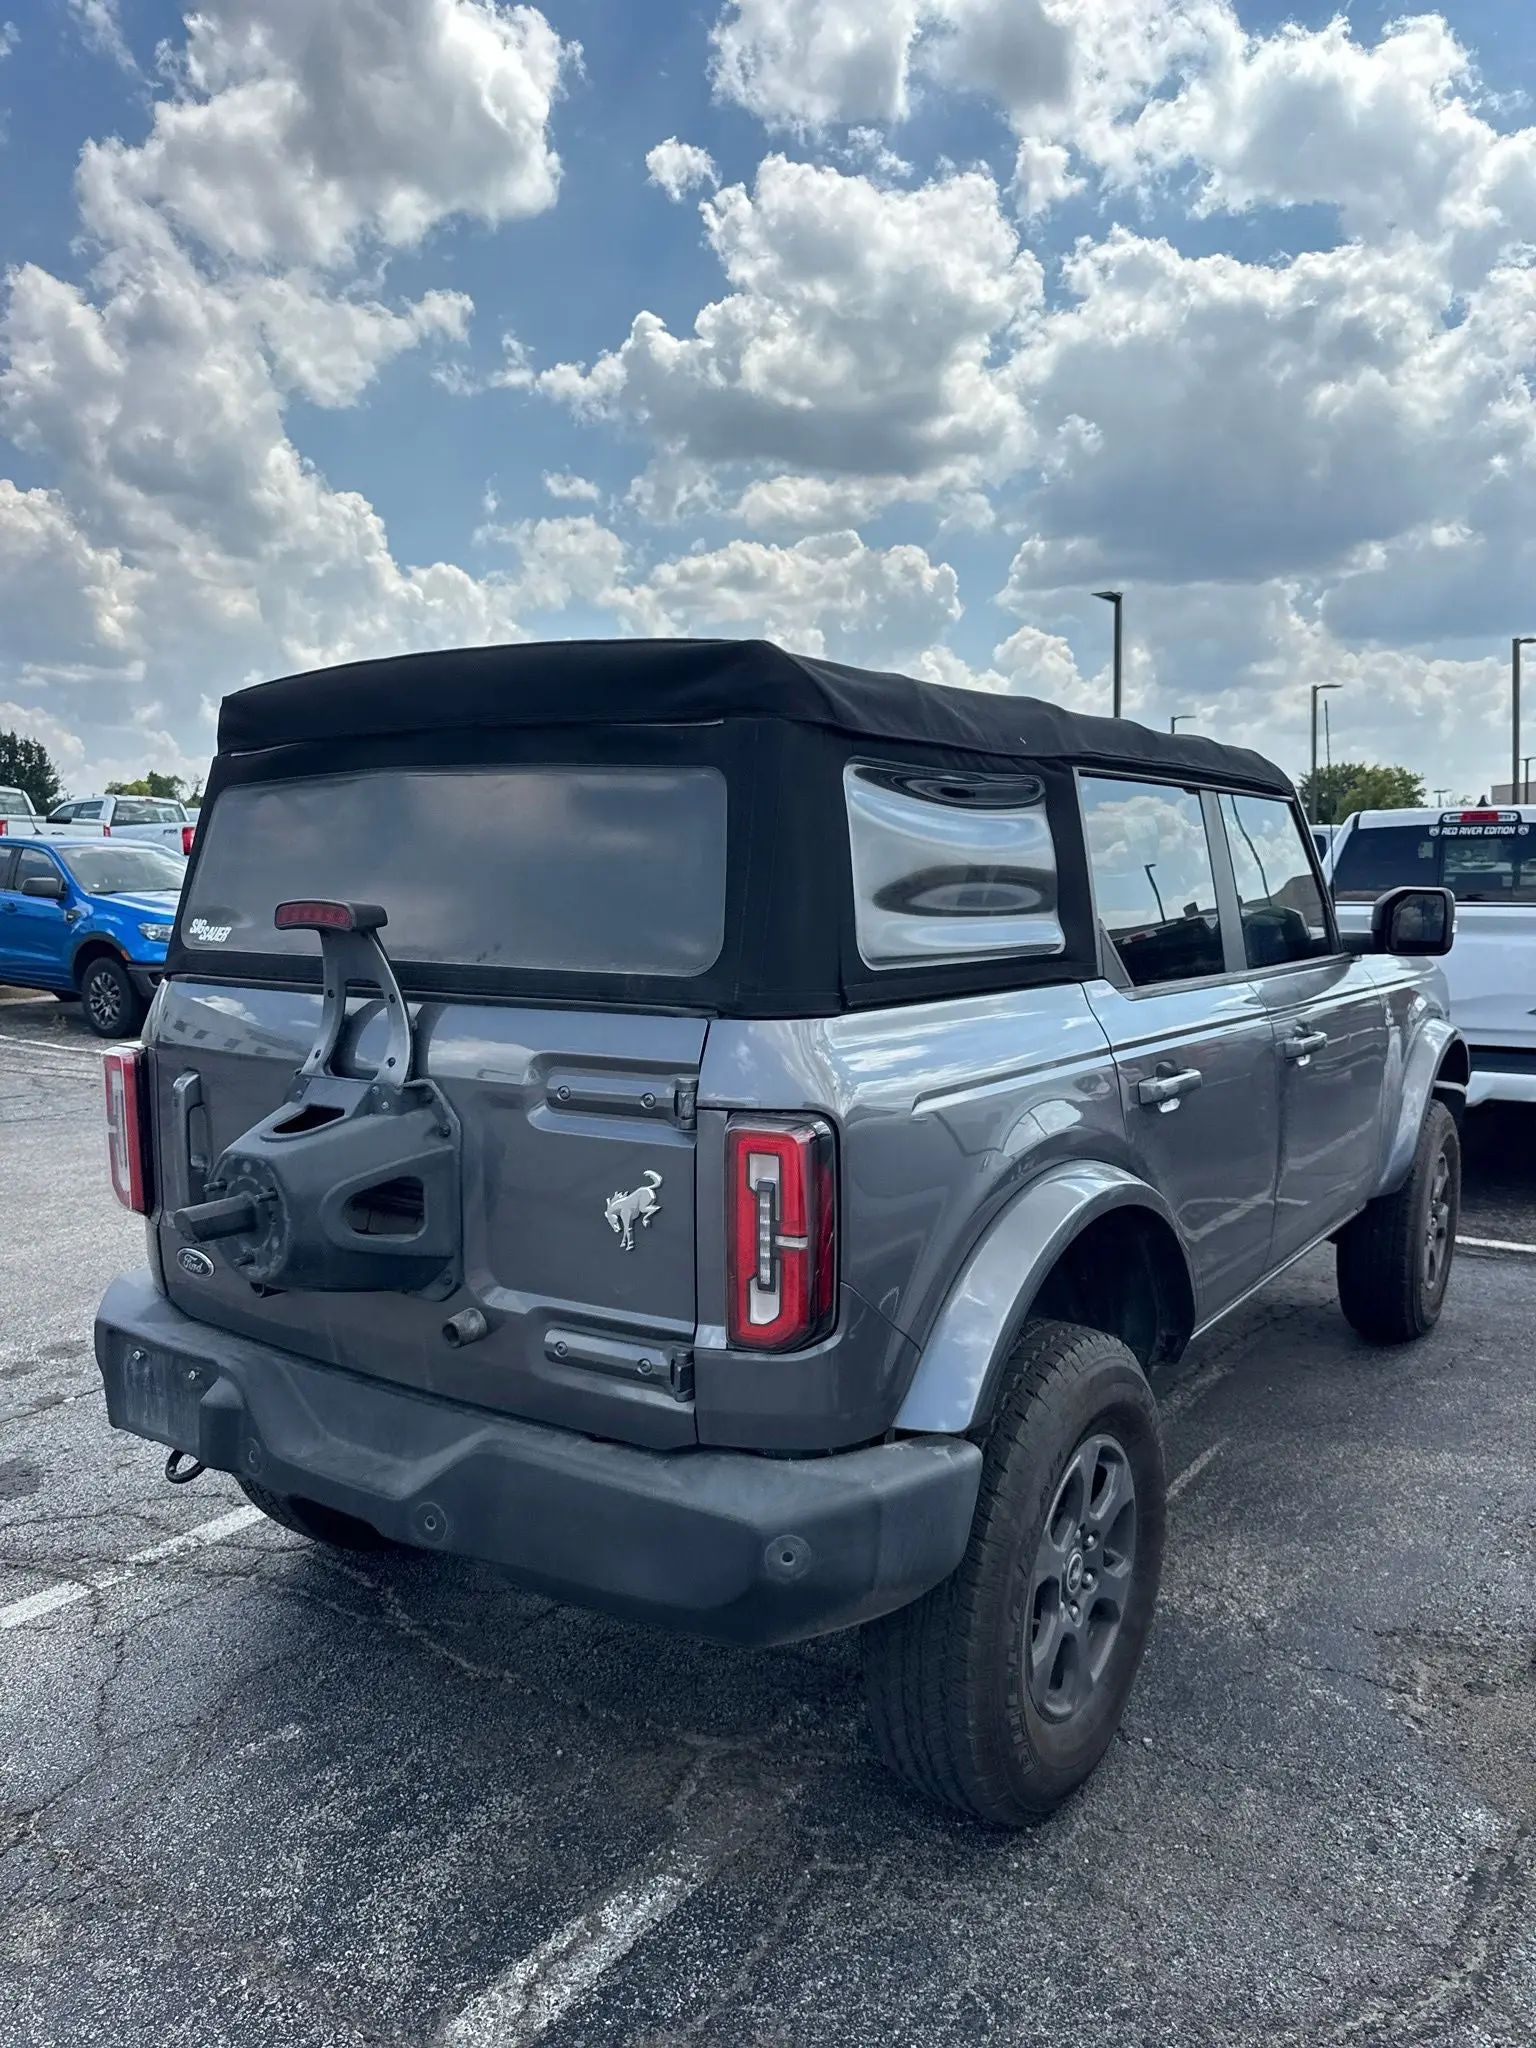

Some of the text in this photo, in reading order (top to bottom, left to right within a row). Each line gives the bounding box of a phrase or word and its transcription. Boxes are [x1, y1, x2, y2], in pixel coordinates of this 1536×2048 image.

[1441, 826, 1516, 836] RED RIVER EDITION
[189, 918, 208, 934] SIG
[198, 926, 232, 943] SAUER
